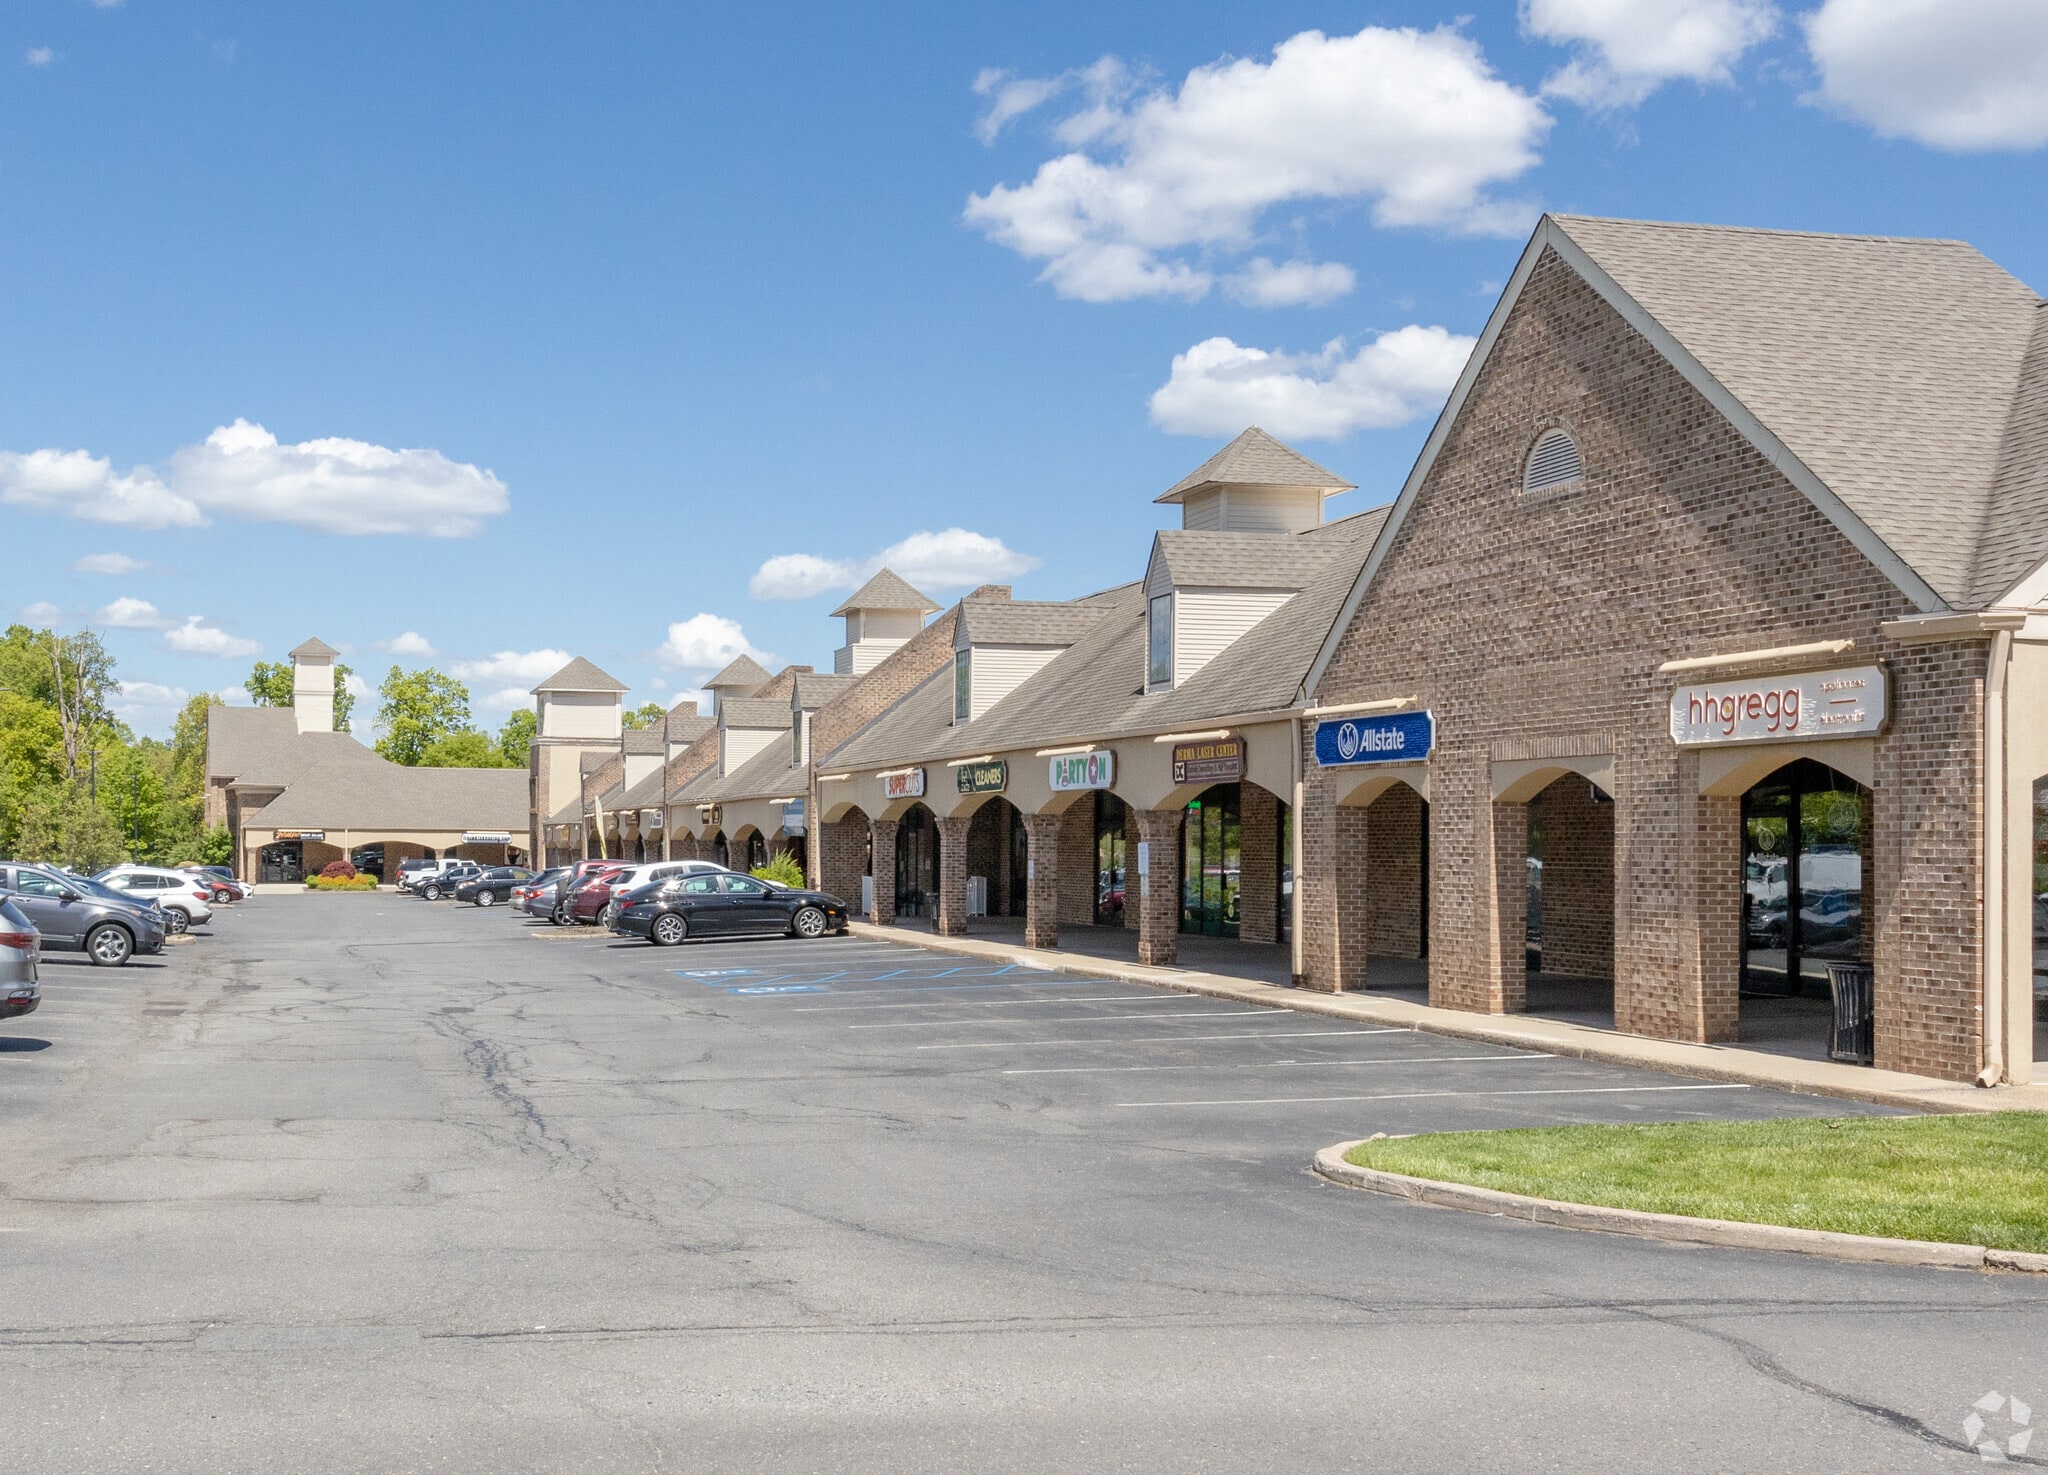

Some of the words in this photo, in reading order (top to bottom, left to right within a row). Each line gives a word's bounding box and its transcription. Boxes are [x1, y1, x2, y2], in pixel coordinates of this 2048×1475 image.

[1689, 688, 1801, 735] hhgregg
[1197, 745, 1215, 759] LASER
[1216, 743, 1238, 758] CENTER
[1359, 727, 1405, 753] Allstate
[975, 768, 1001, 786] CLEANERS
